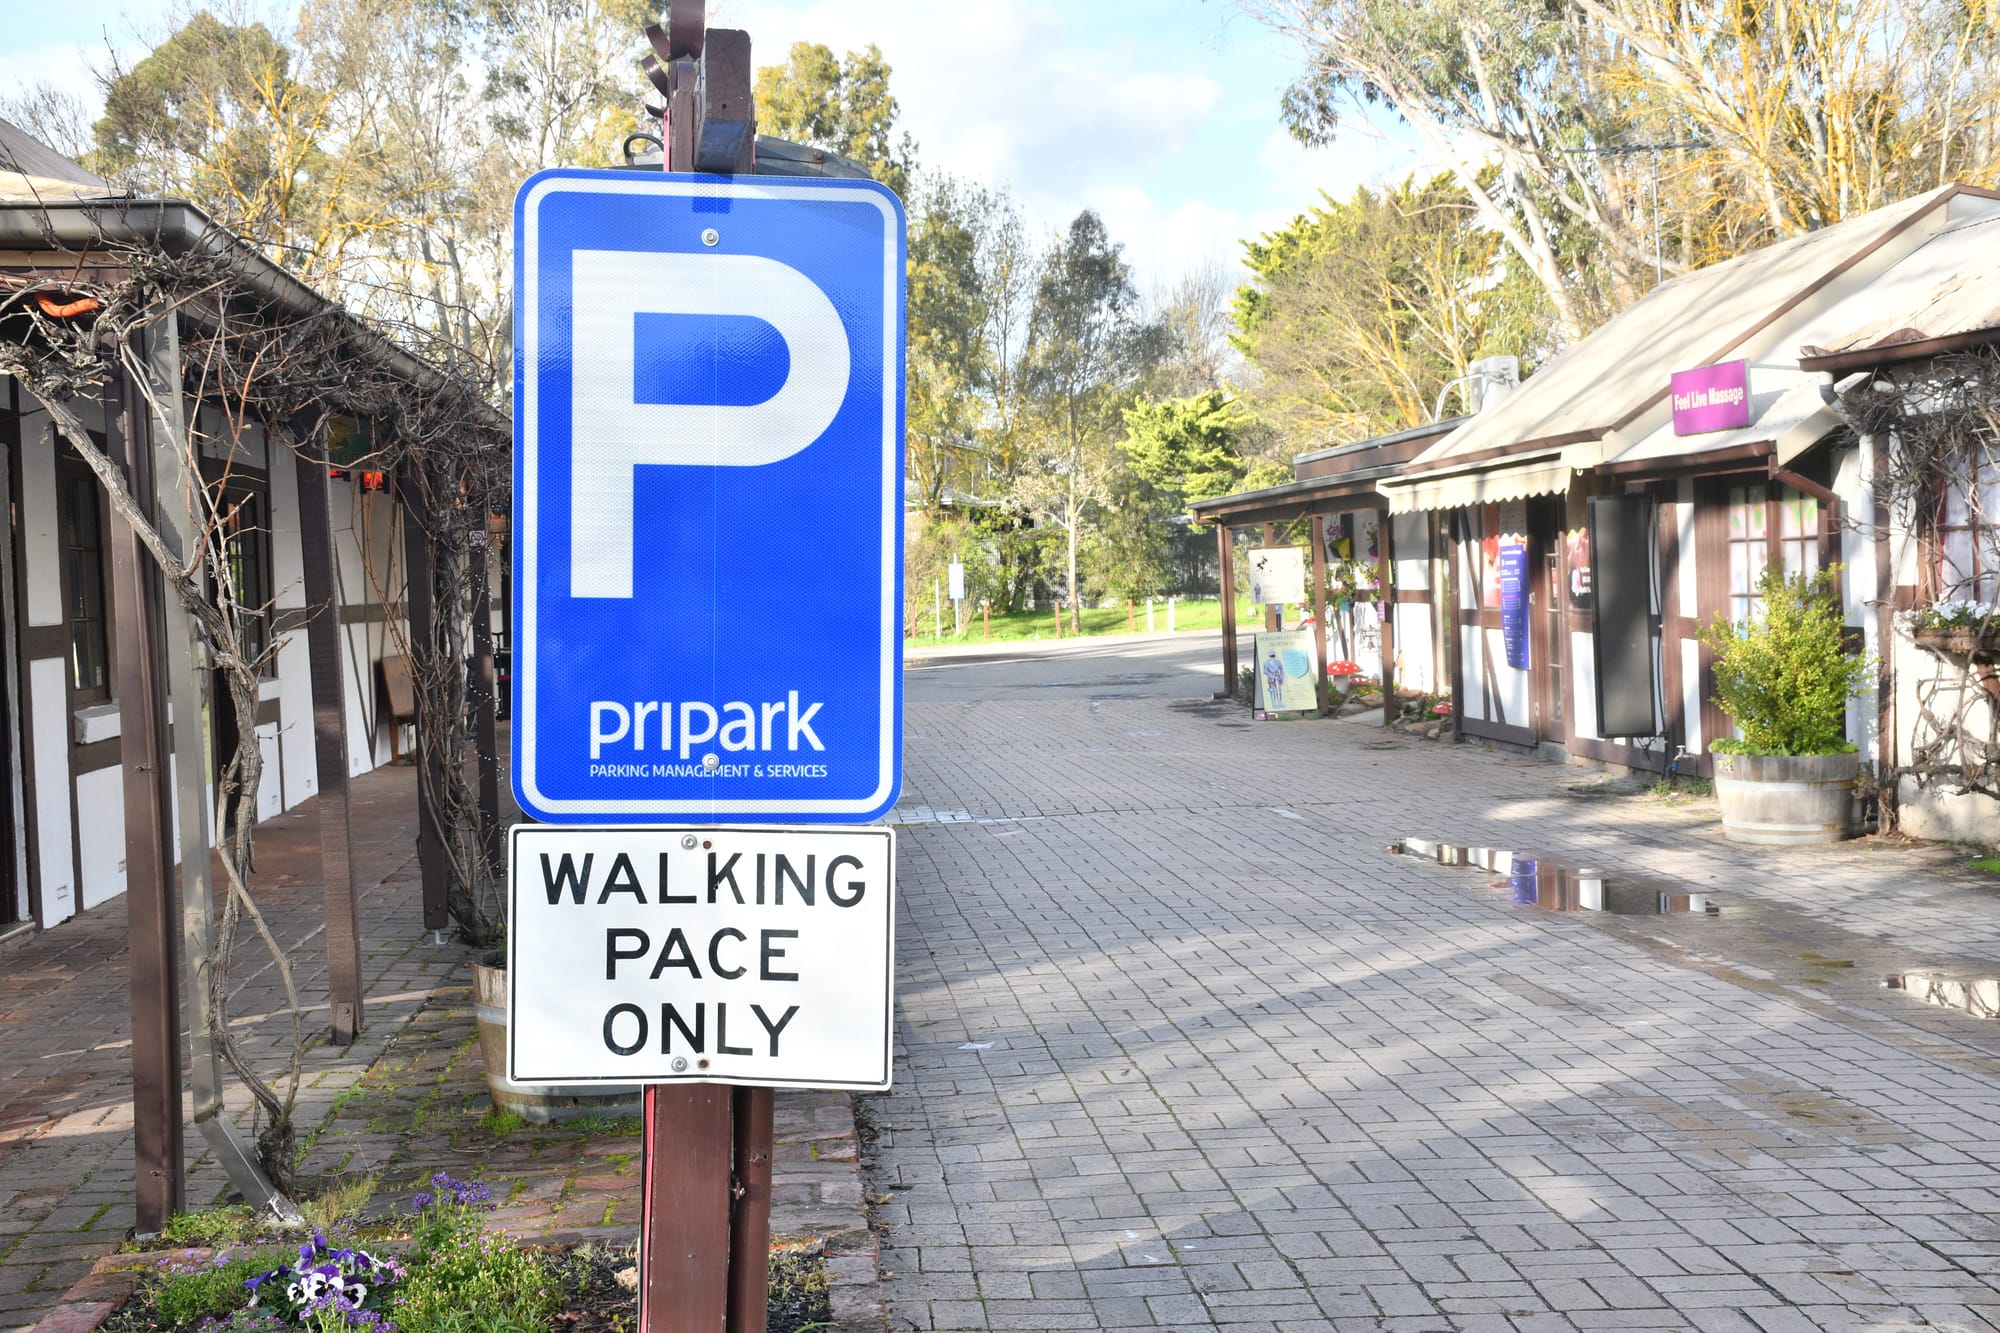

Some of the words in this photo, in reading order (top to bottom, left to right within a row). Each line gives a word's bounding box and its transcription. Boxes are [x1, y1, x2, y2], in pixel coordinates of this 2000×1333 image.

[570, 249, 851, 598] P
[1674, 392, 1691, 411] Feel
[1691, 390, 1707, 409] Live
[1708, 387, 1743, 406] Massage
[590, 690, 826, 760] pripark
[590, 764, 649, 778] PARKING
[652, 764, 750, 778] MANAGEMENT
[753, 764, 764, 778] &
[767, 764, 828, 778] SERVICES
[539, 852, 866, 908] WALKING
[605, 927, 800, 982] PACE
[602, 1002, 801, 1057] ONLY
